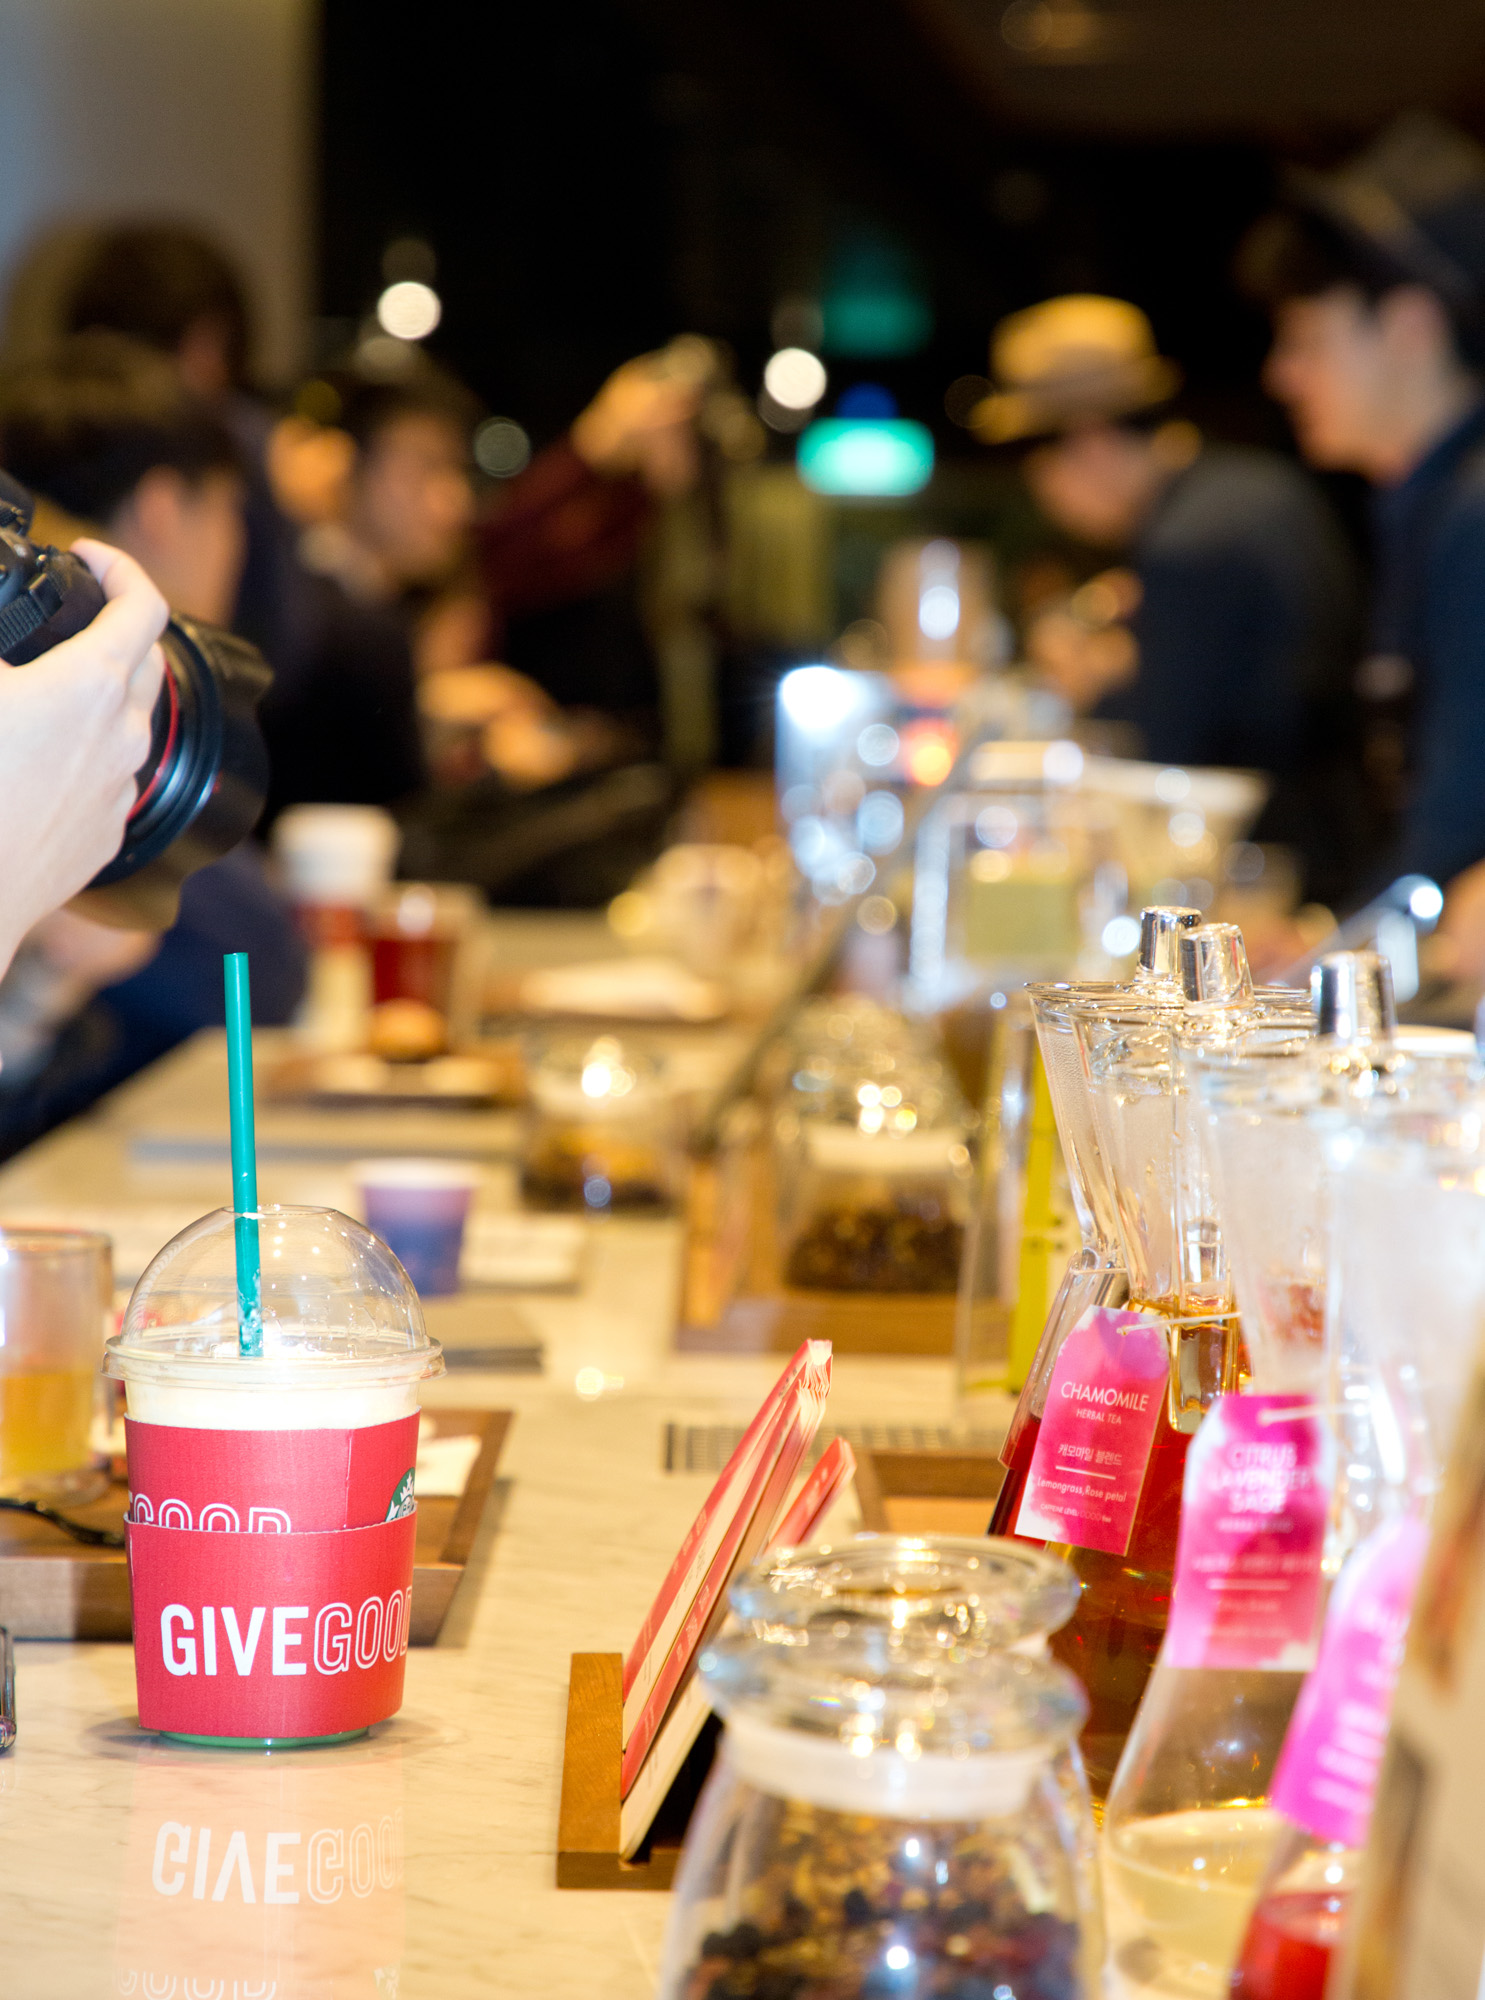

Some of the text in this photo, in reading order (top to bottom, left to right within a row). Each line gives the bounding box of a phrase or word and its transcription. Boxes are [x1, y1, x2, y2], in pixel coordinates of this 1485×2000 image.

[1061, 1381, 1149, 1412] CHAMOMILE
[1076, 1408, 1122, 1425] HERBAL TEA
[1105, 1491, 1128, 1503] petal
